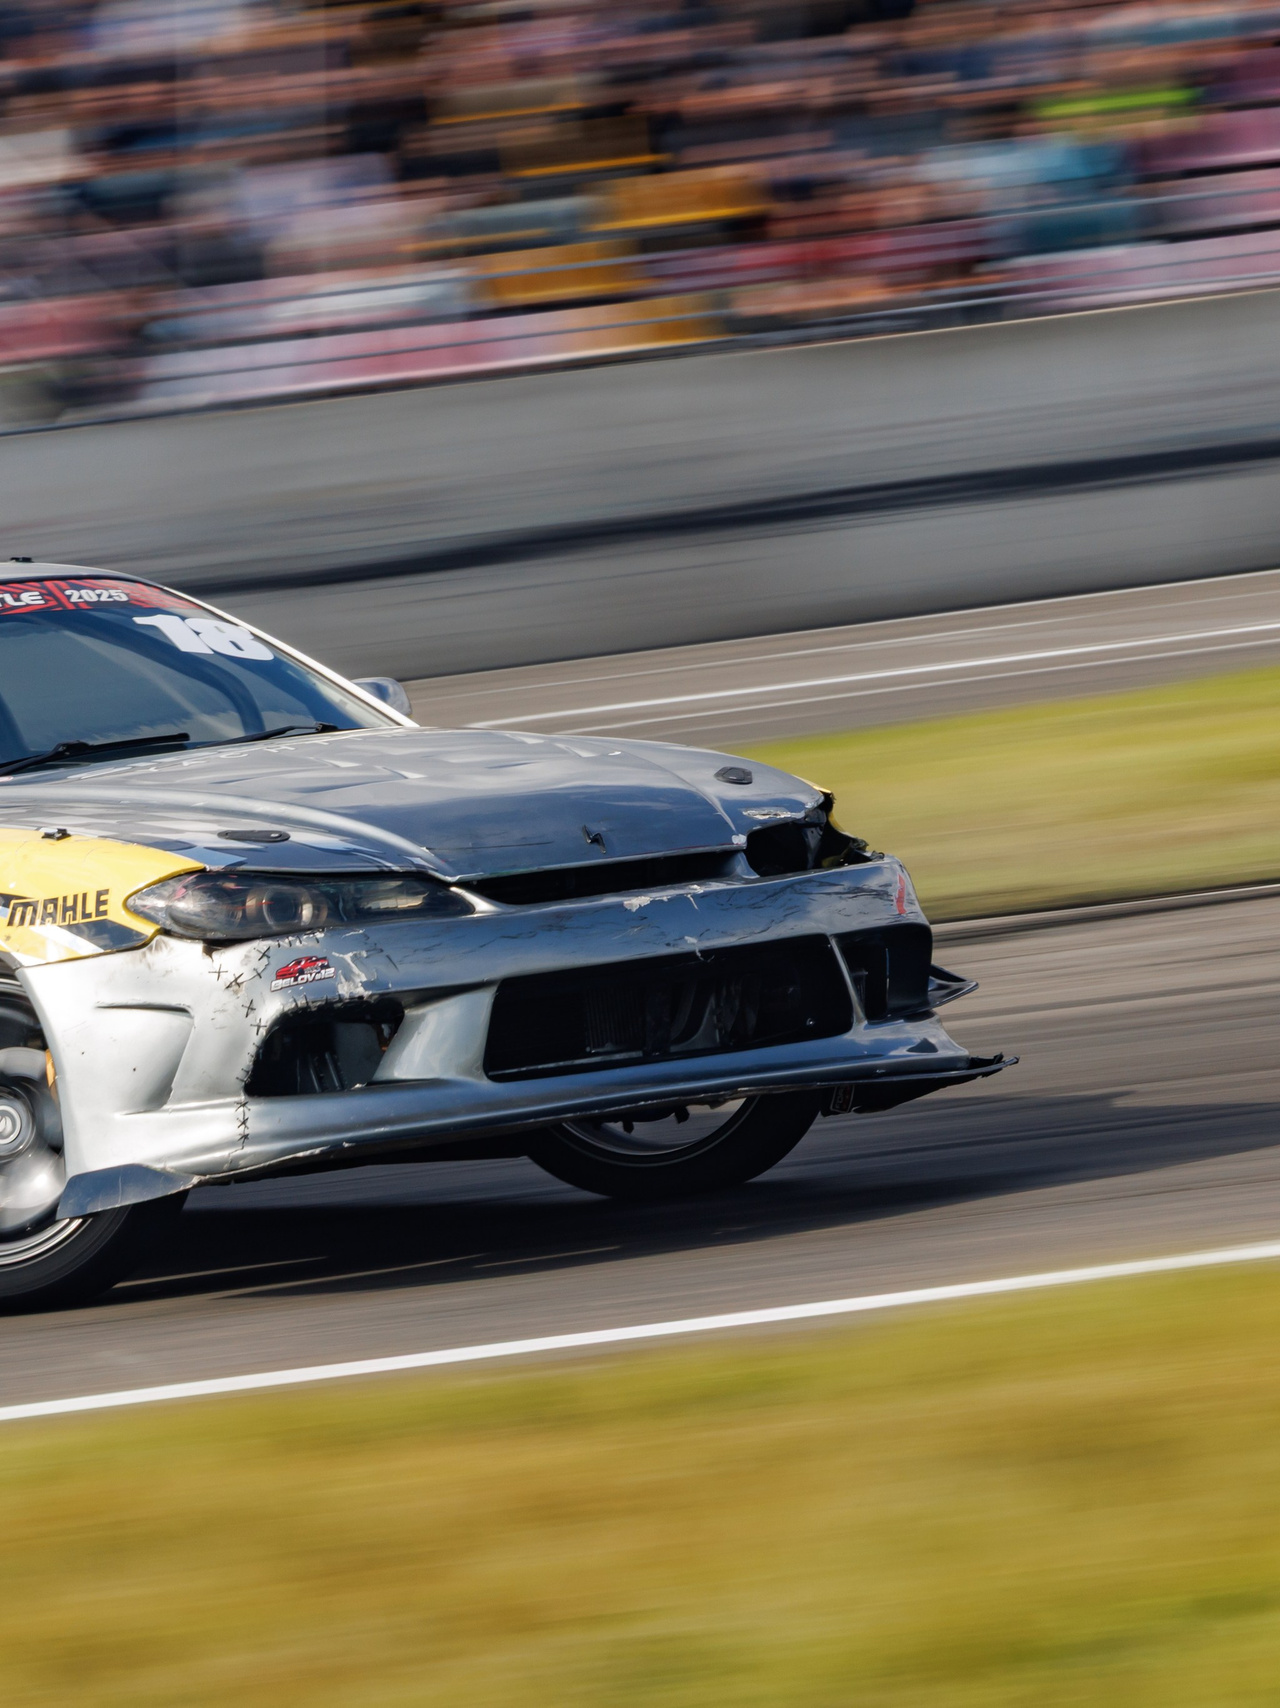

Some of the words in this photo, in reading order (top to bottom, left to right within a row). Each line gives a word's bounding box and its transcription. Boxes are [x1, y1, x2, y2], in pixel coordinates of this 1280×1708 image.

[65, 589, 129, 603] 2025
[132, 613, 275, 661] 18
[7, 889, 110, 927] MAHLE
